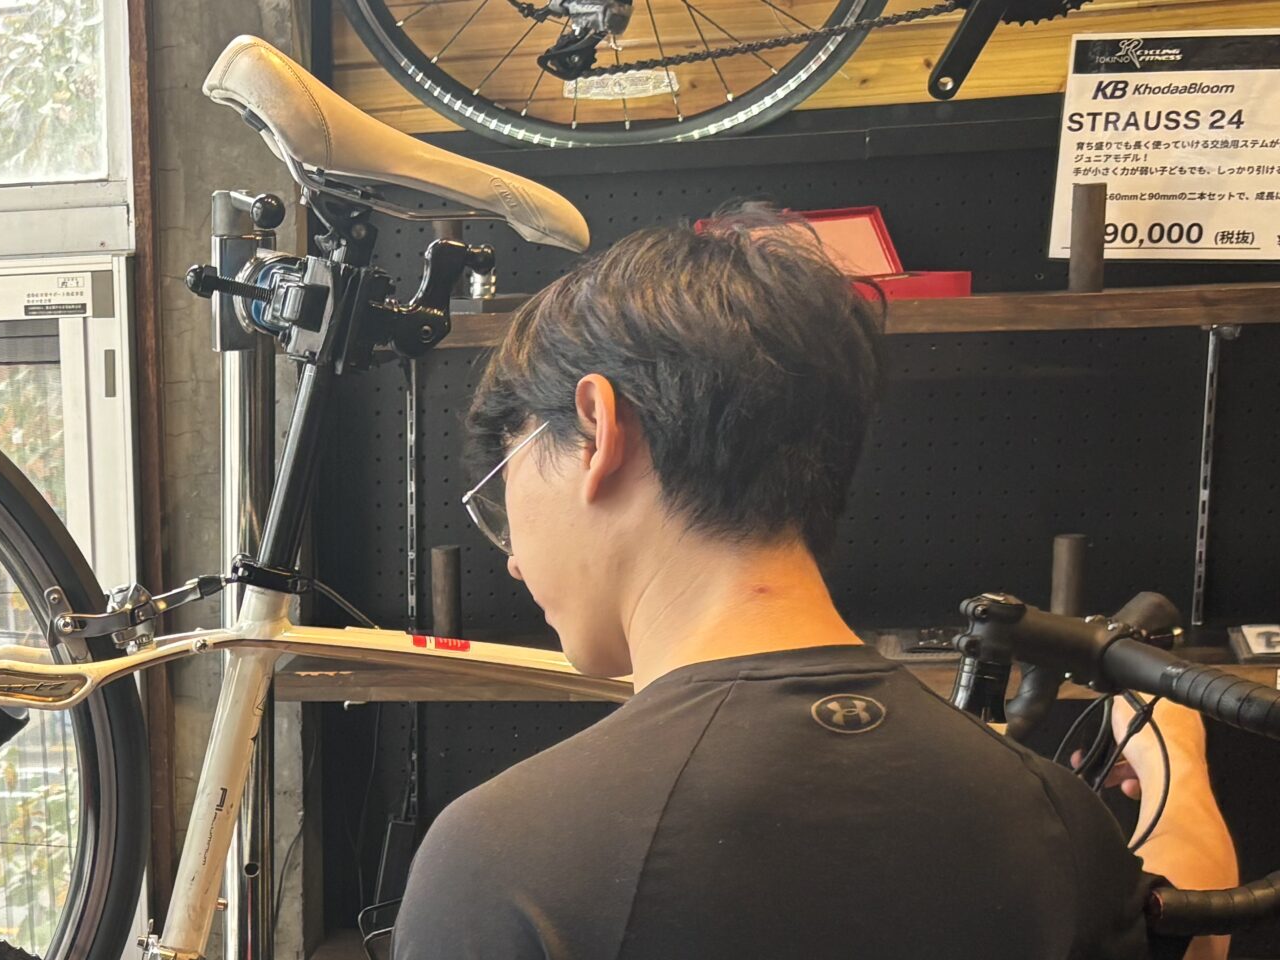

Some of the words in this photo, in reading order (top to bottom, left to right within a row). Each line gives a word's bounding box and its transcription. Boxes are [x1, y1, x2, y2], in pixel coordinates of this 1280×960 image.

[1092, 80, 1130, 100] KB
[1132, 82, 1235, 96] KhodaaBloom
[1067, 110, 1202, 132] STRAUSS
[1208, 109, 1245, 130] 24
[1105, 191, 1280, 201] 60mmと90mmの二本セットで、成長
